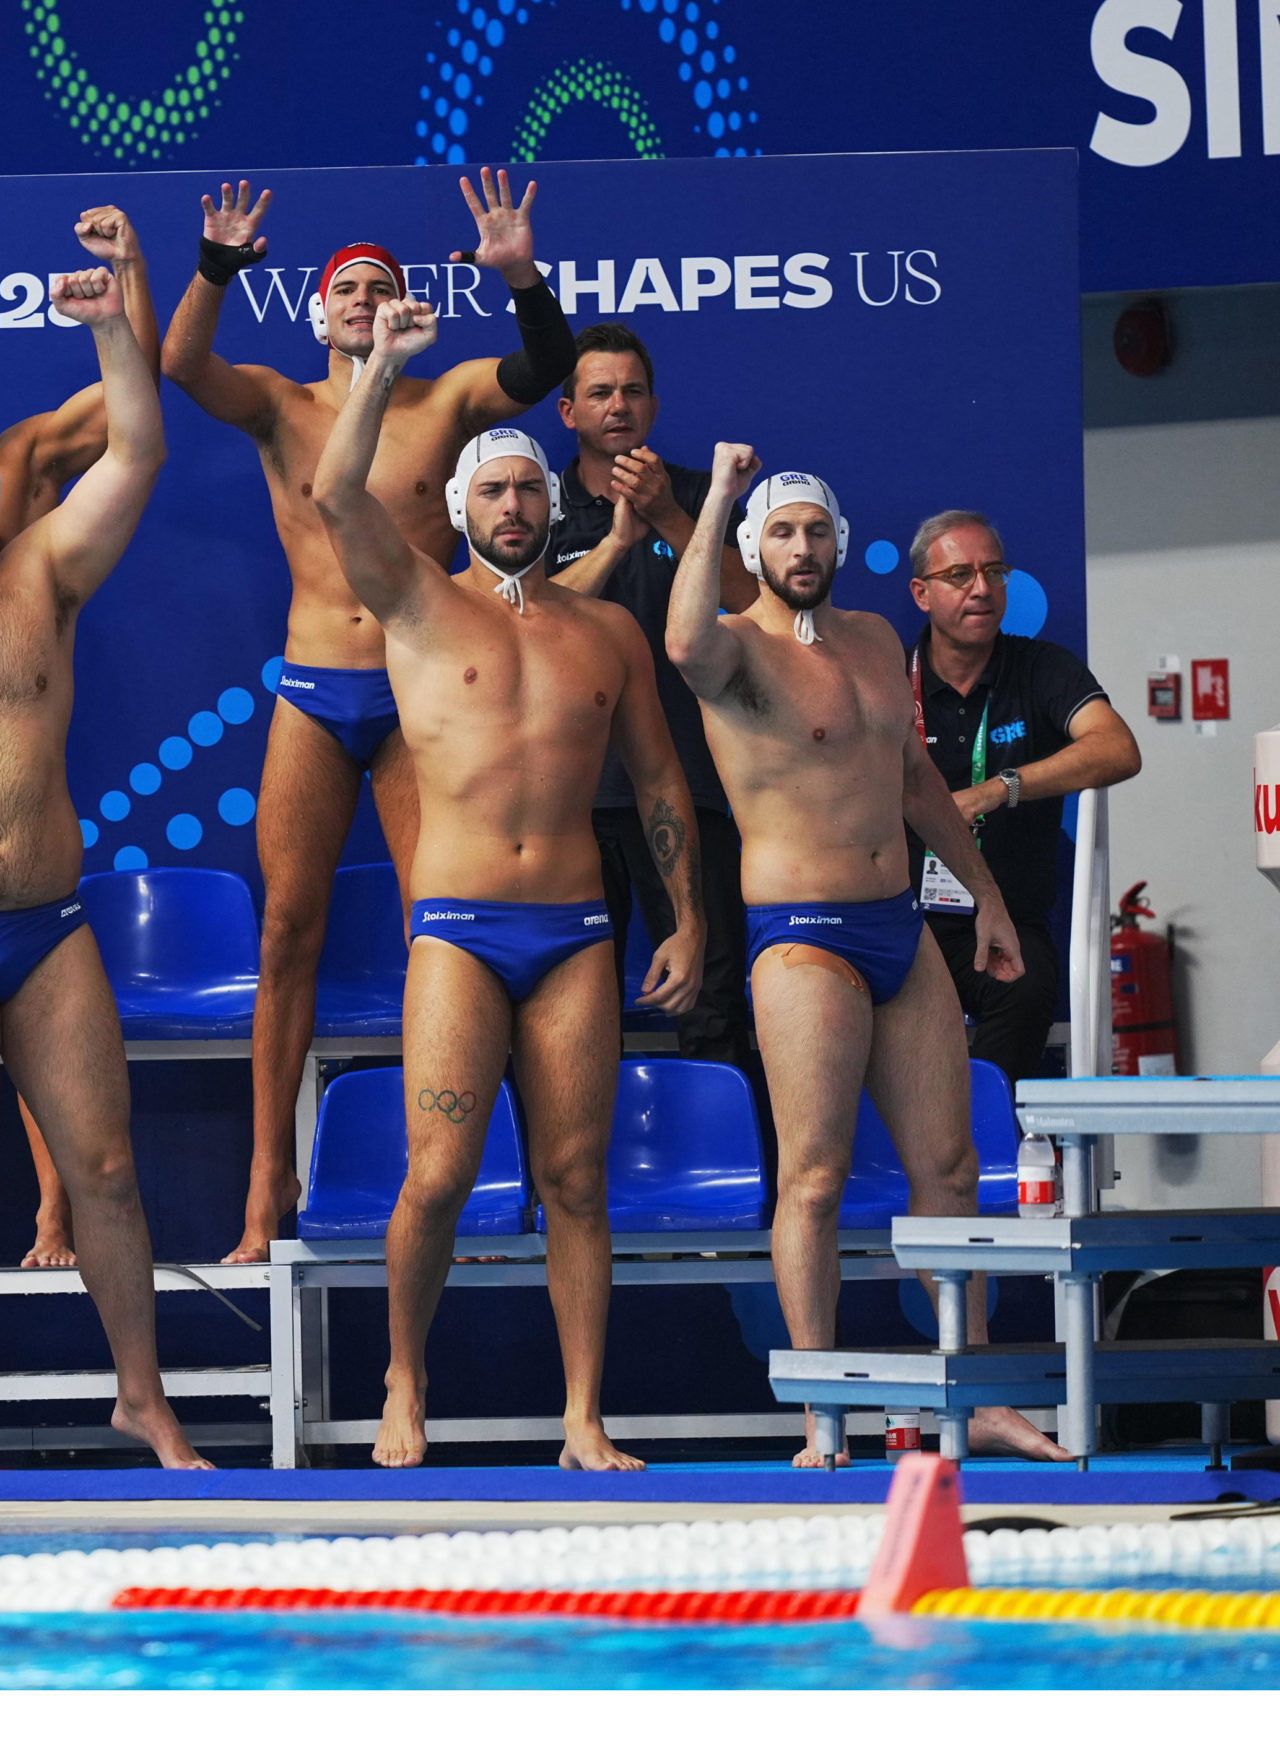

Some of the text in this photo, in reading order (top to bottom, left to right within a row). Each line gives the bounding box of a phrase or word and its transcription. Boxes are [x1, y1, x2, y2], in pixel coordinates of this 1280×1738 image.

[238, 262, 492, 323] WER
[849, 249, 941, 306] US
[780, 474, 808, 482] GRE
[989, 719, 1027, 745] GRE
[422, 911, 475, 923] Stoiximan
[583, 914, 609, 926] arena
[788, 915, 843, 926] Stoiximan
